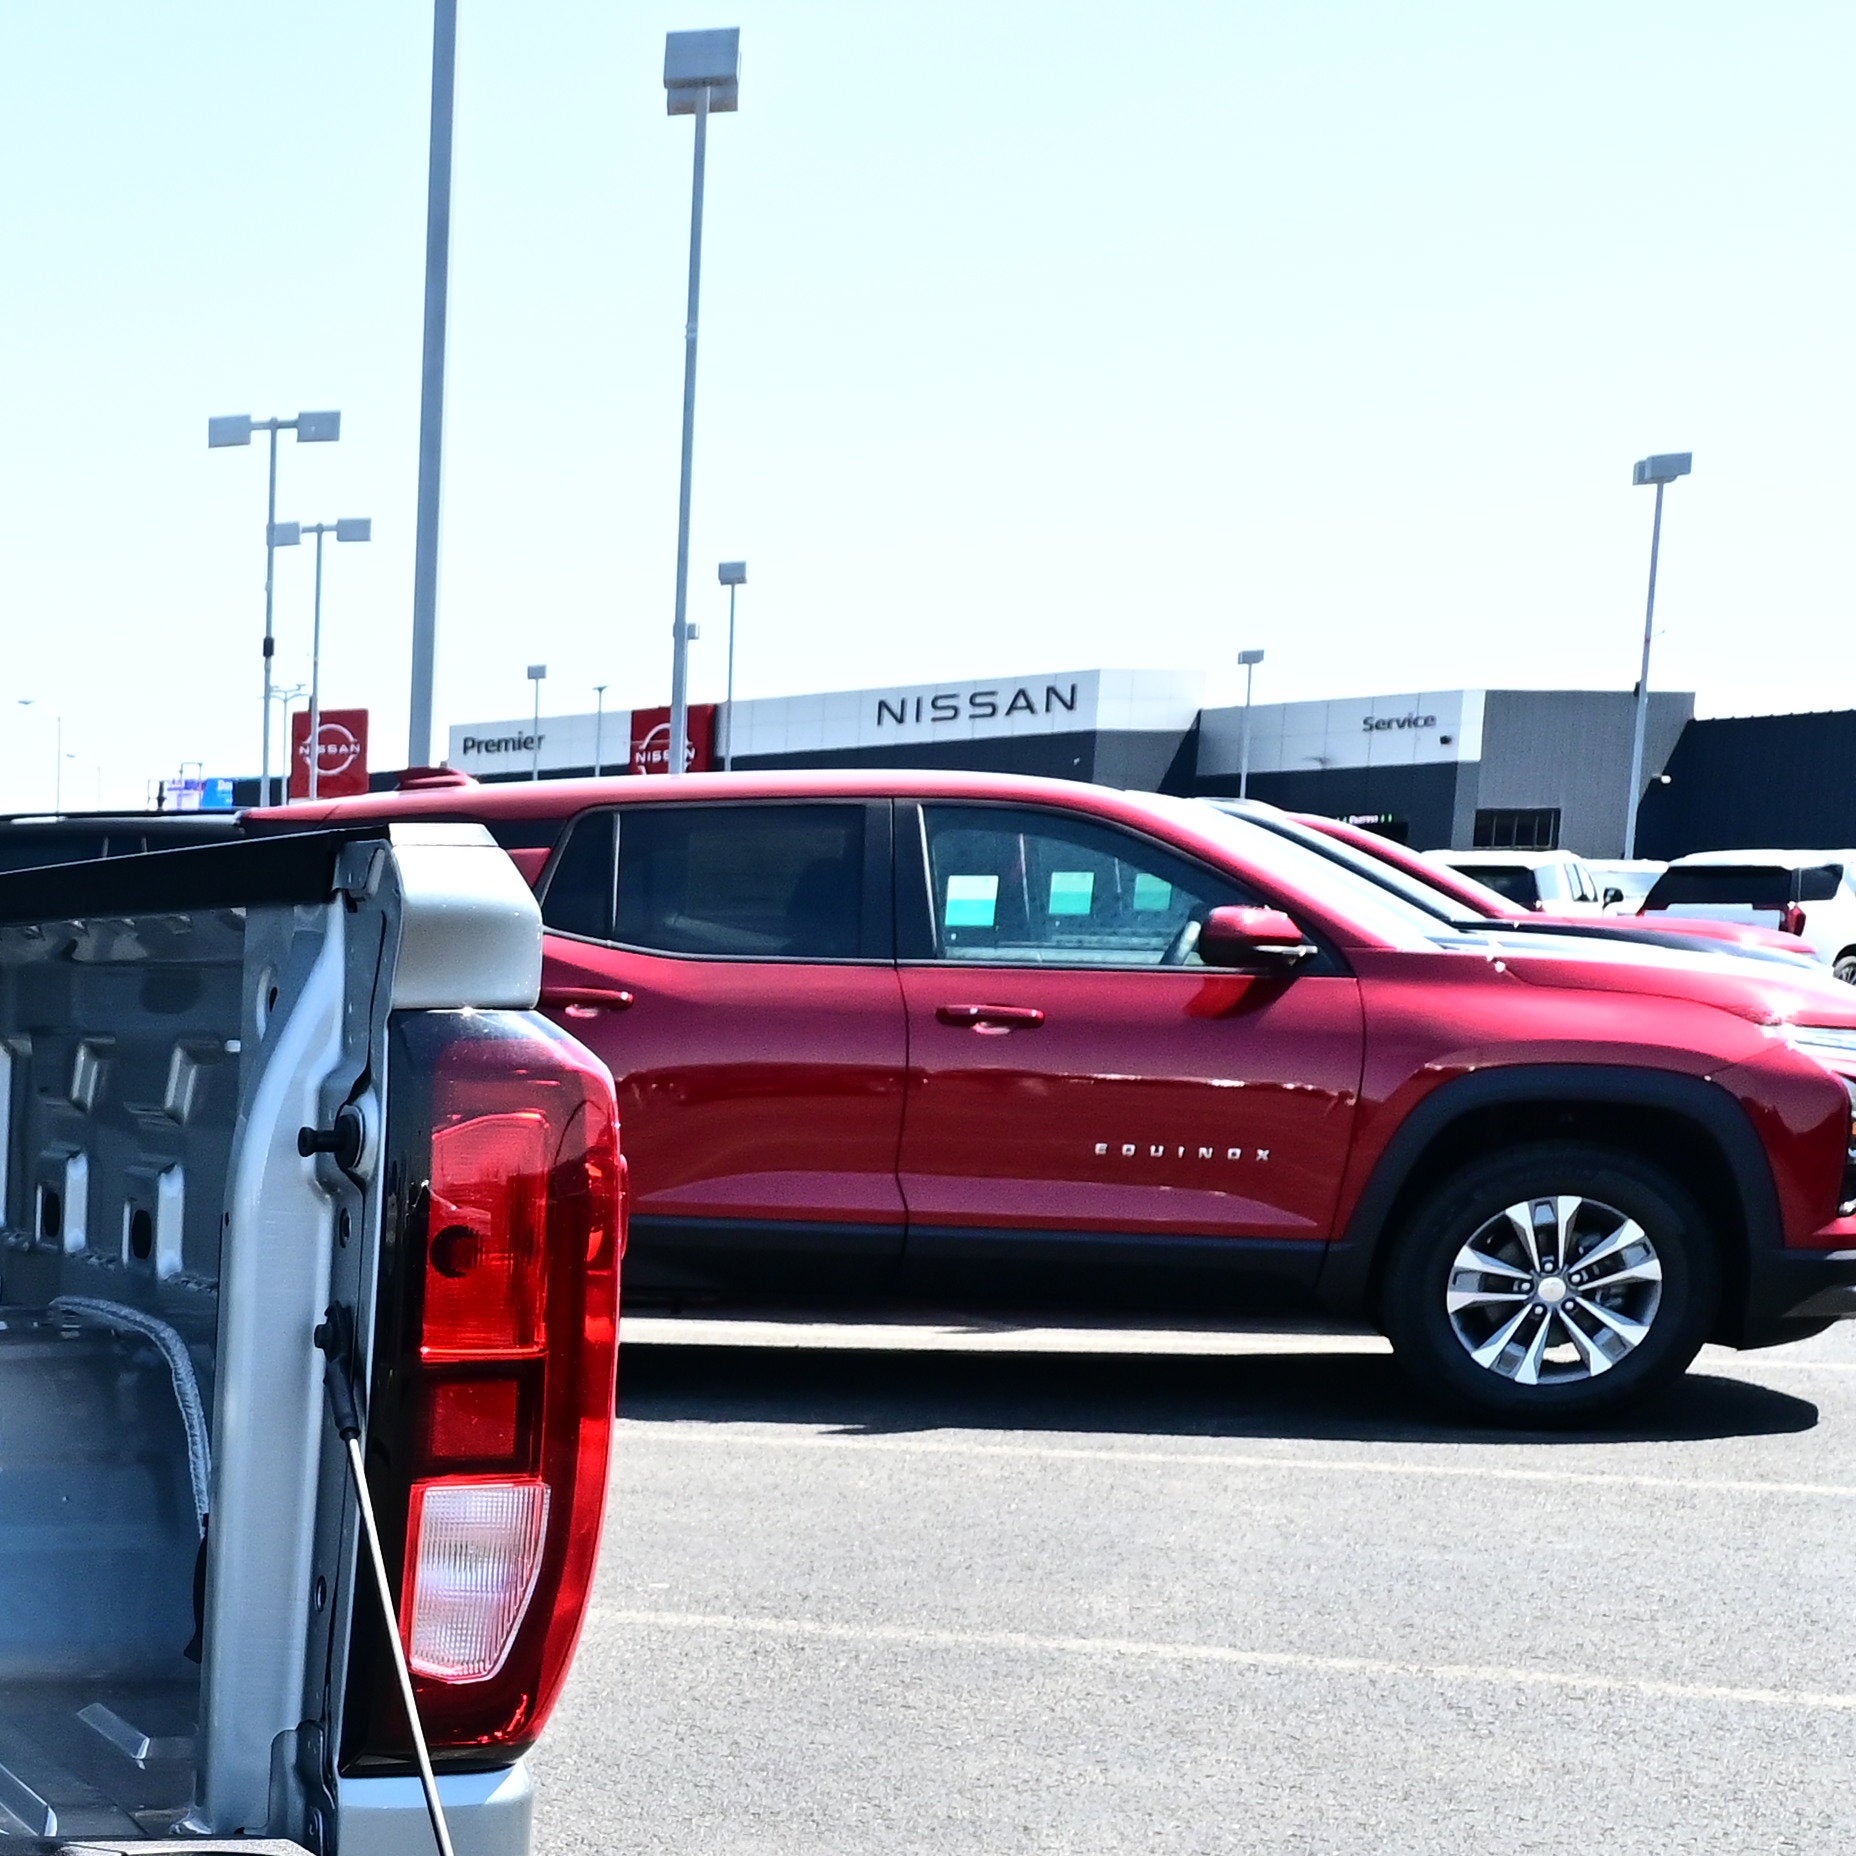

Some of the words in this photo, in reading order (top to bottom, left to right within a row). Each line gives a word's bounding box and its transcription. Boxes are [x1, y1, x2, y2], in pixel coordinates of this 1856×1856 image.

[877, 683, 1077, 726] NISSAN
[1362, 712, 1437, 732] Service
[299, 743, 360, 756] NSSAN
[463, 731, 545, 755] Premier
[635, 747, 695, 763] NISSN
[1095, 1143, 1270, 1161] EQUINOX
